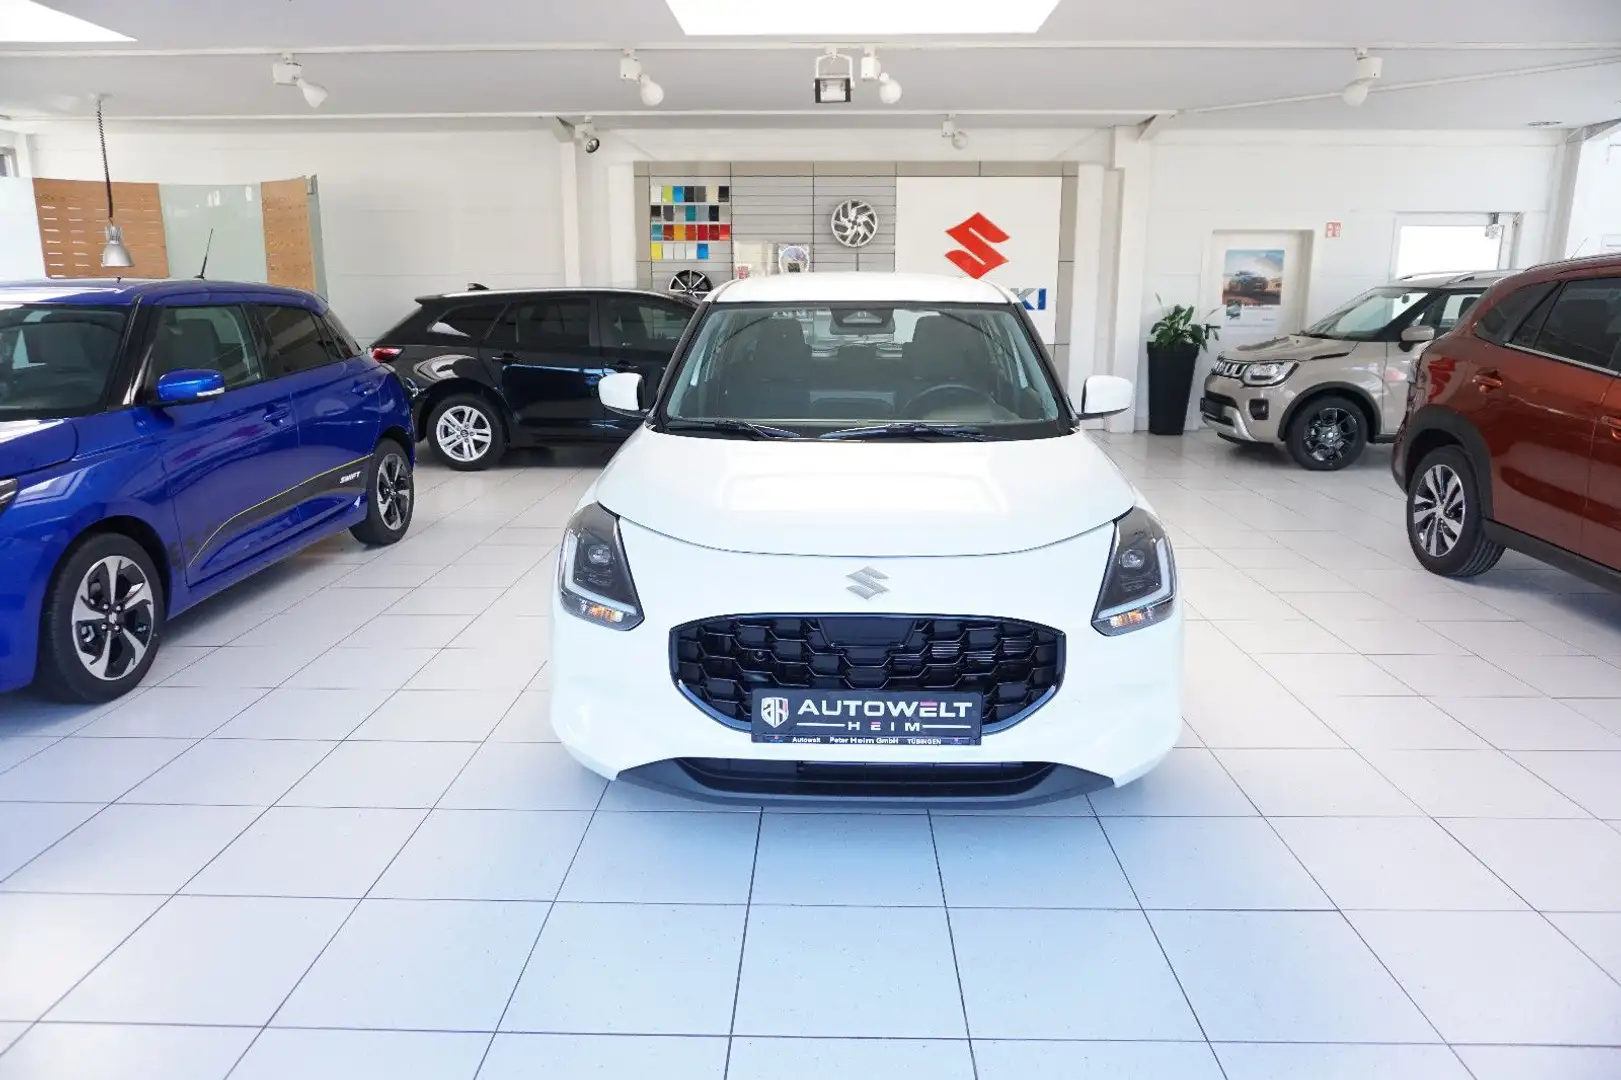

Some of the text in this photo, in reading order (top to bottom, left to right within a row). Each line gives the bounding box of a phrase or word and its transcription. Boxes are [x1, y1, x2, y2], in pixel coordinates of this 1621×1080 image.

[797, 699, 973, 718] AUTOWELT
[848, 721, 920, 732] HEIM
[829, 736, 849, 744] Peter
[876, 737, 899, 745] GmbH
